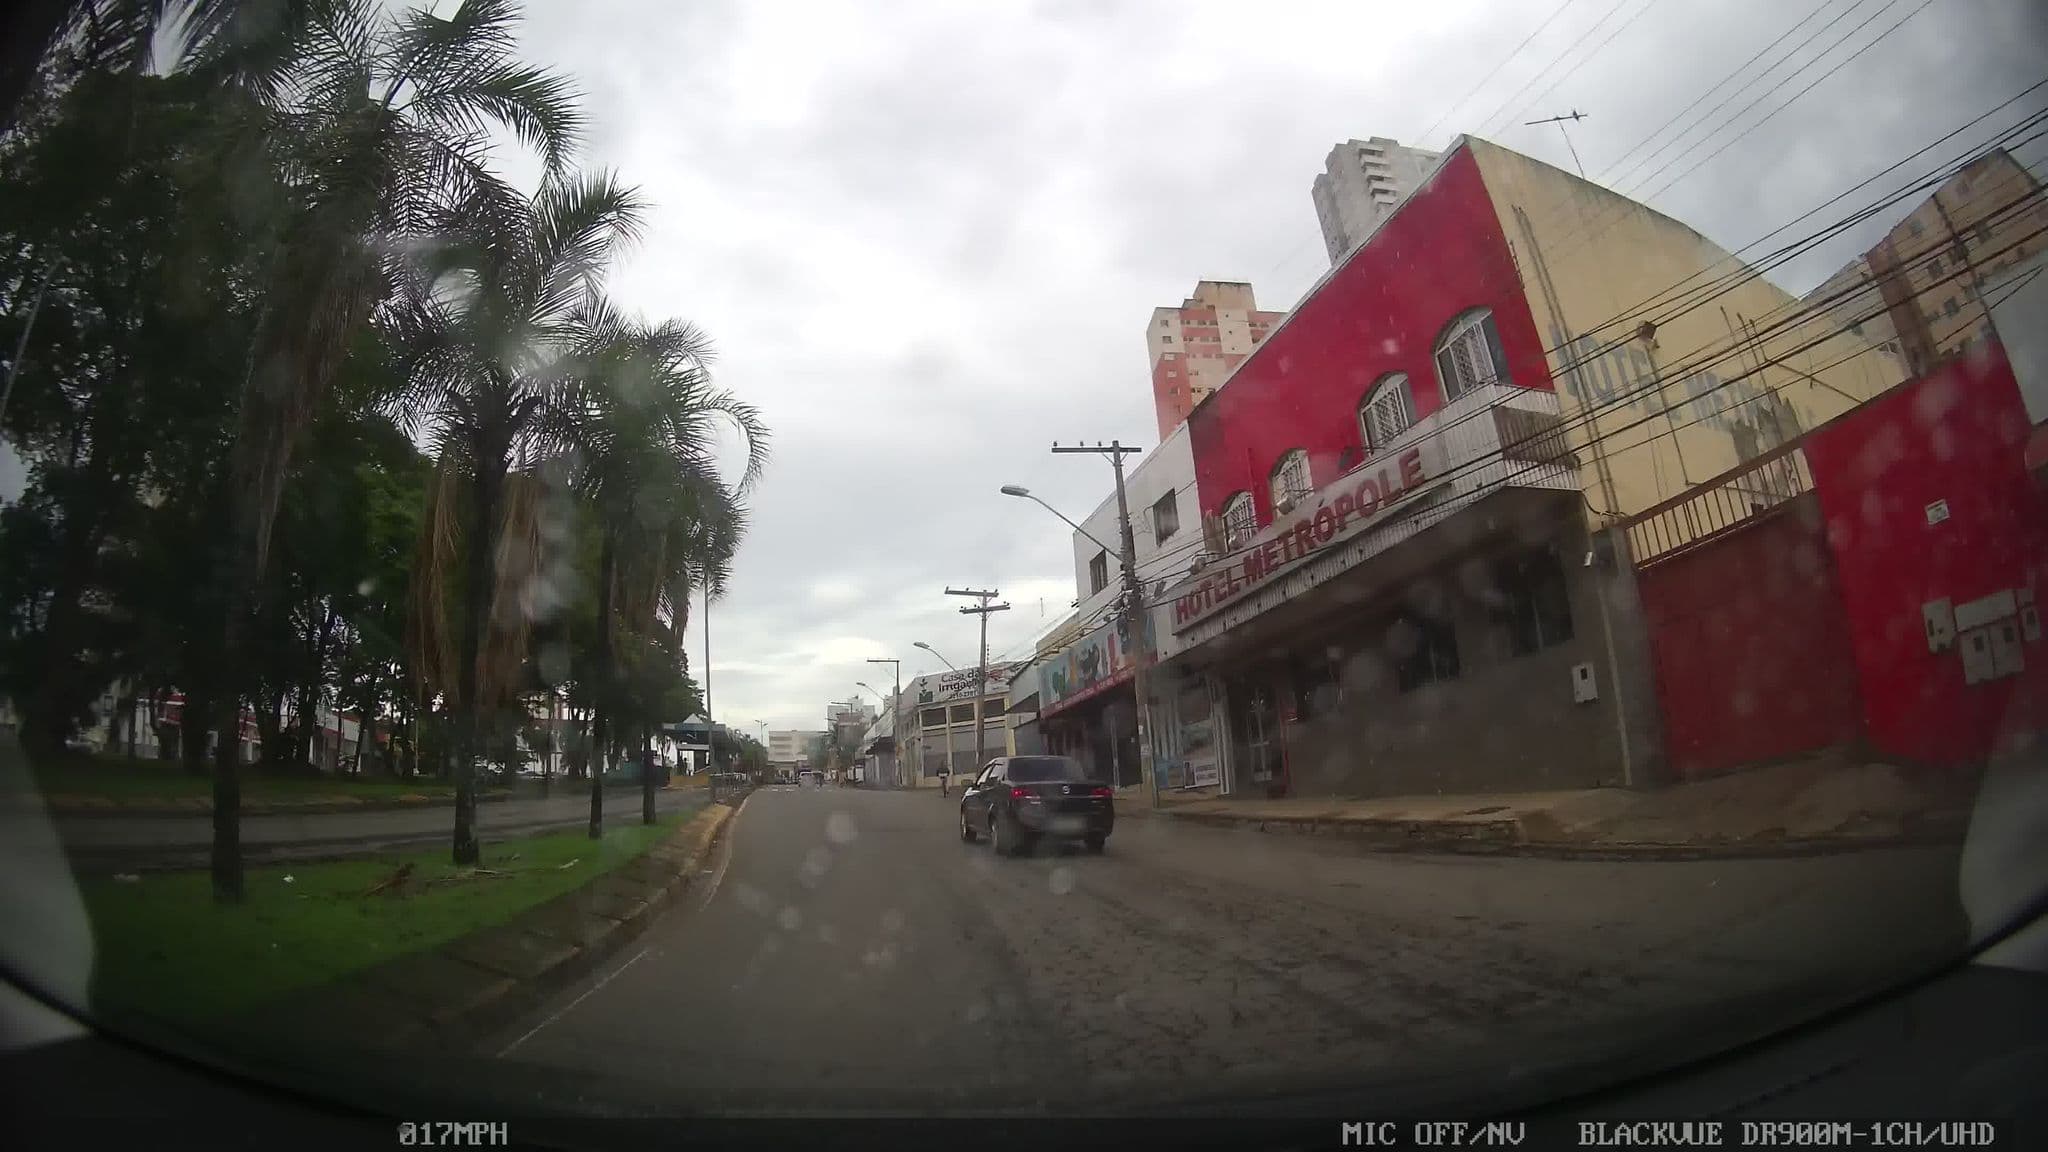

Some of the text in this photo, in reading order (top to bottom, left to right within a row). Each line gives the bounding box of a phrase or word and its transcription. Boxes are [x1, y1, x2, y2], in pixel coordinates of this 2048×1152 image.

[1175, 447, 1426, 625] HOTEL METRÓPOLE
[941, 673, 965, 683] Casa
